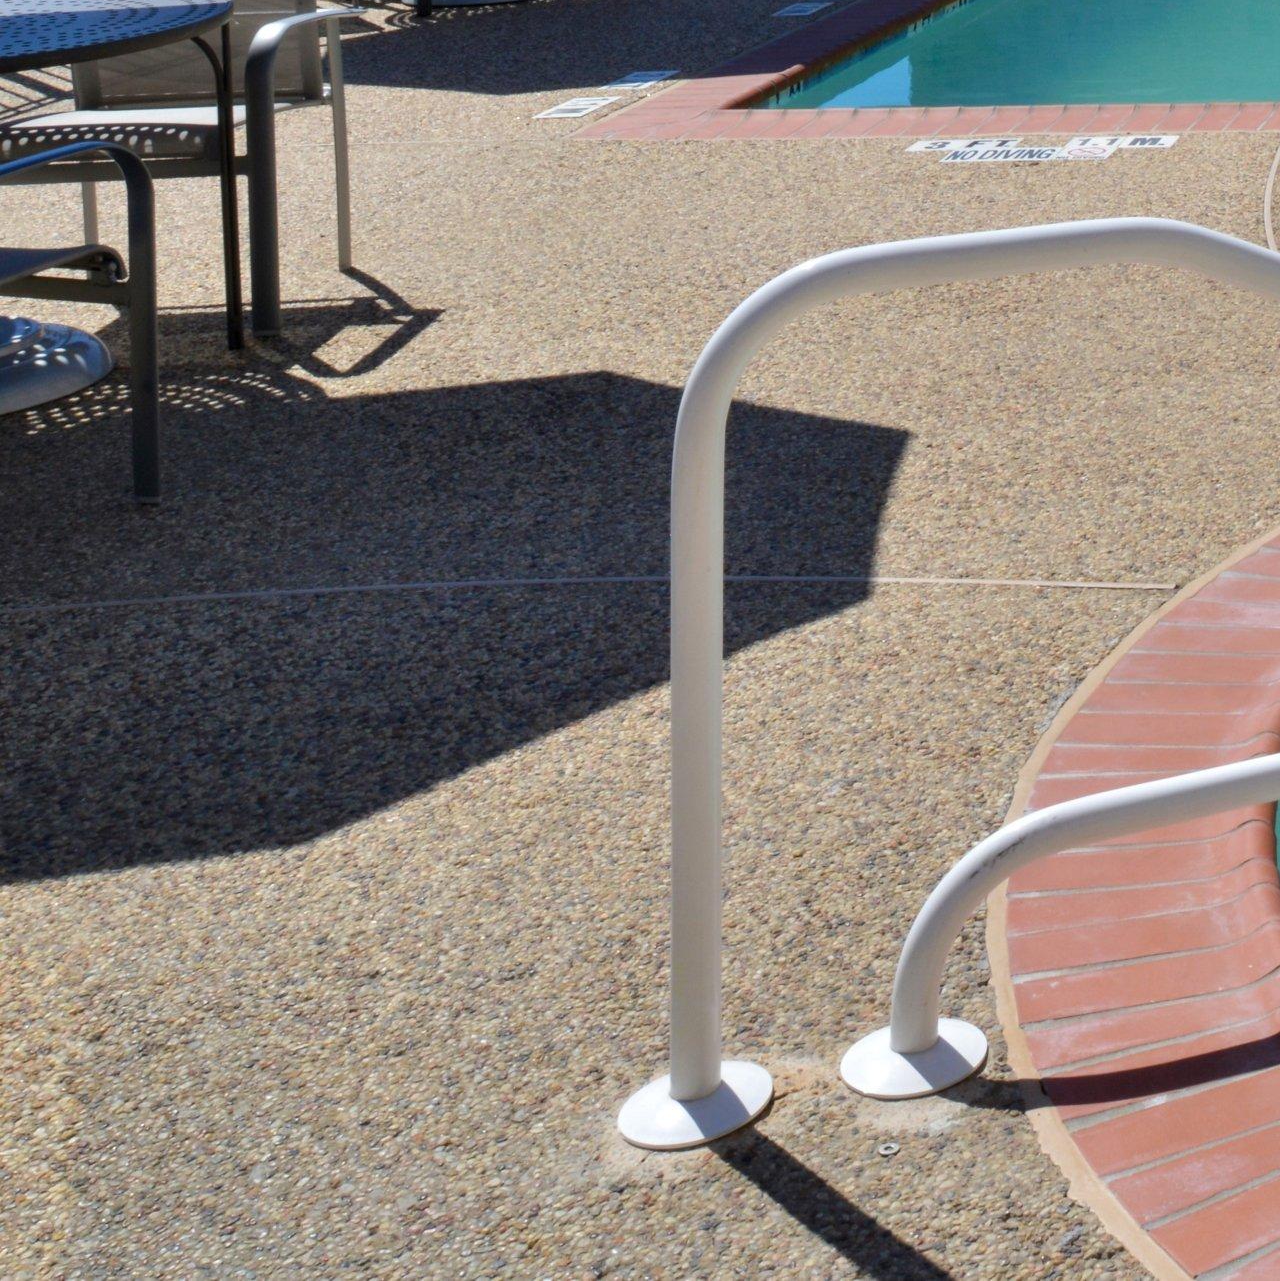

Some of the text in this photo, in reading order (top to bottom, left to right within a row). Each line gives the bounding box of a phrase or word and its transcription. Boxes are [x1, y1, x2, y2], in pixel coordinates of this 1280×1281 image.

[924, 141, 950, 149] 3
[1079, 138, 1119, 146] 1.1
[1128, 138, 1165, 146] M.
[945, 150, 979, 160] NO
[979, 149, 1056, 160] DIVING
